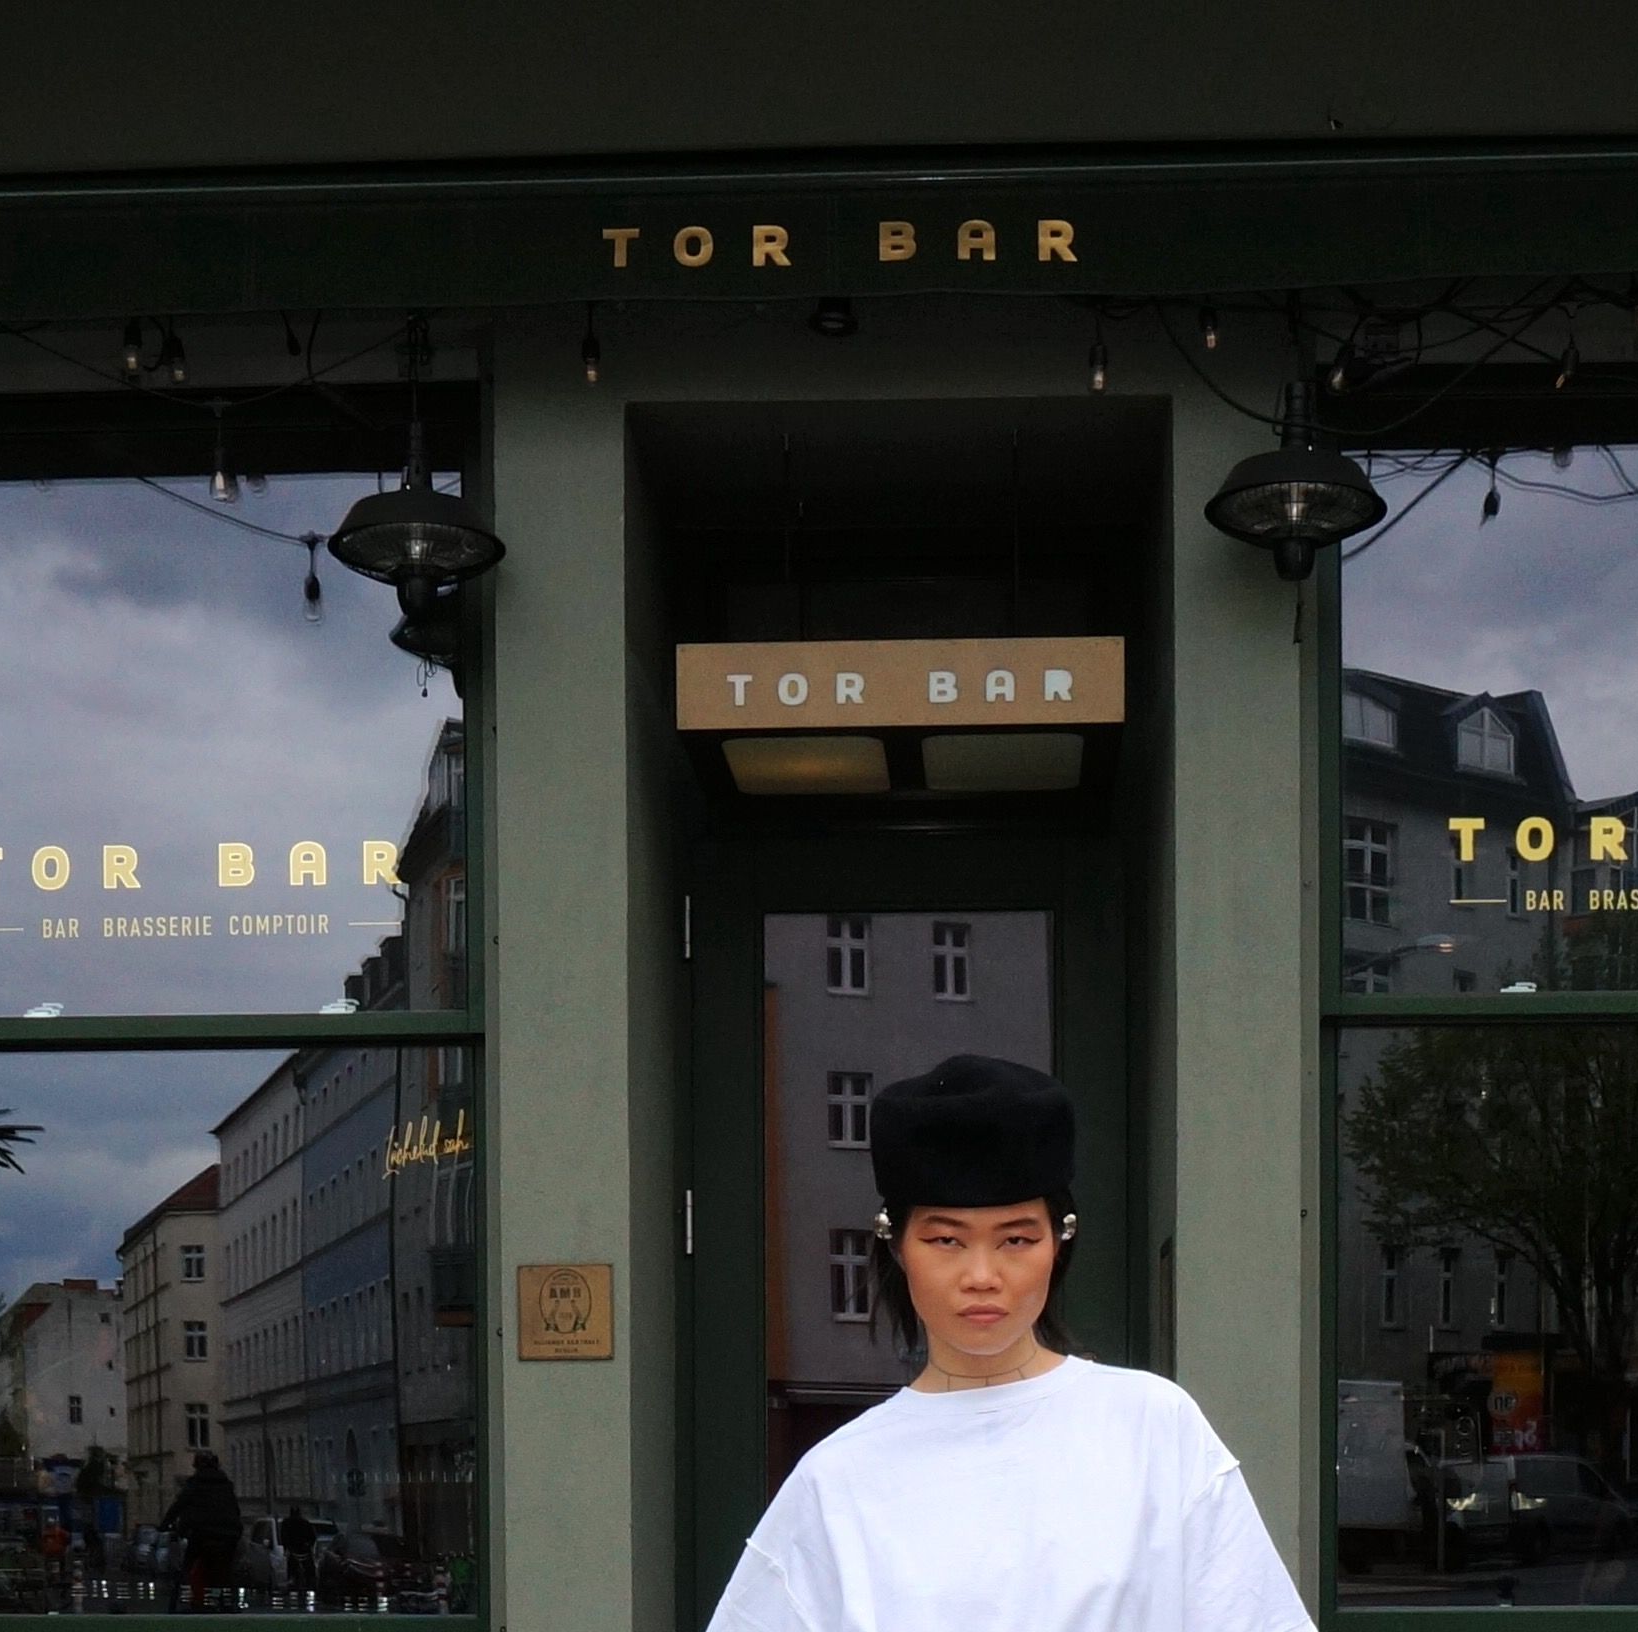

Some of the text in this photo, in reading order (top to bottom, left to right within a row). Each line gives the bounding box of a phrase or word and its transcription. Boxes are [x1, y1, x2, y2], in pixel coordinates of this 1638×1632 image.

[602, 219, 1078, 268] TOR BAR
[725, 668, 1074, 707] TOR BAR
[1448, 816, 1629, 863] TOR
[217, 840, 402, 888] BAR
[1525, 890, 1565, 912] BAR
[41, 913, 330, 940] BAR BRASSERIE COMPTOIR
